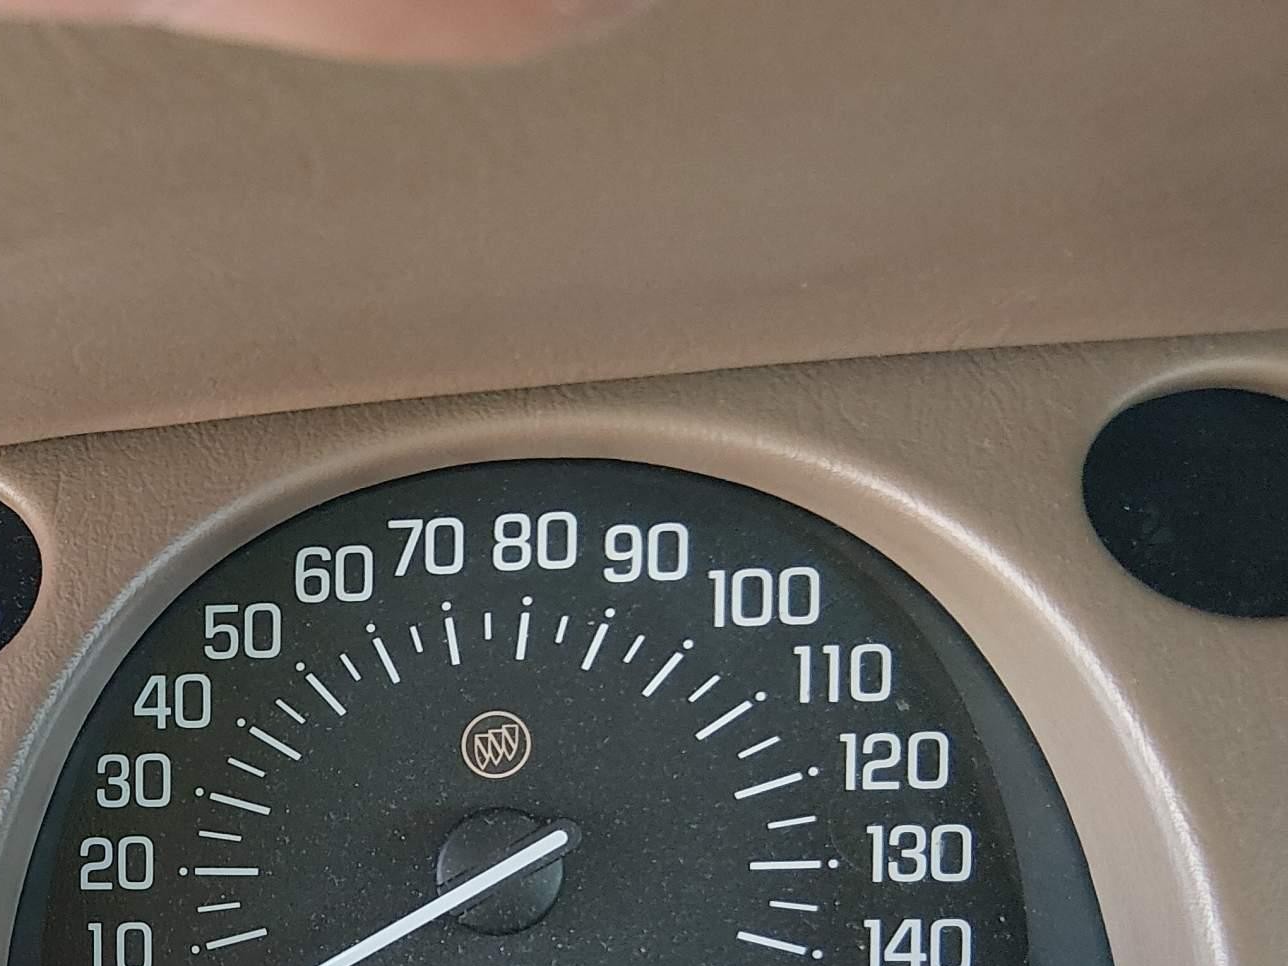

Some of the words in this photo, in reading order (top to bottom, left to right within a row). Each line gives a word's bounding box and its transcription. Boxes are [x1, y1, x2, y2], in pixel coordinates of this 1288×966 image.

[388, 517, 464, 577] 70
[492, 511, 578, 572] 80
[603, 522, 689, 583] 90
[295, 545, 374, 603] 60
[708, 566, 820, 628] 100
[204, 602, 282, 660] 50
[134, 673, 211, 729] 40
[793, 643, 892, 704] 110
[96, 752, 171, 808] 30
[839, 731, 950, 791] 120
[80, 835, 154, 890] 20
[866, 823, 973, 883] 130
